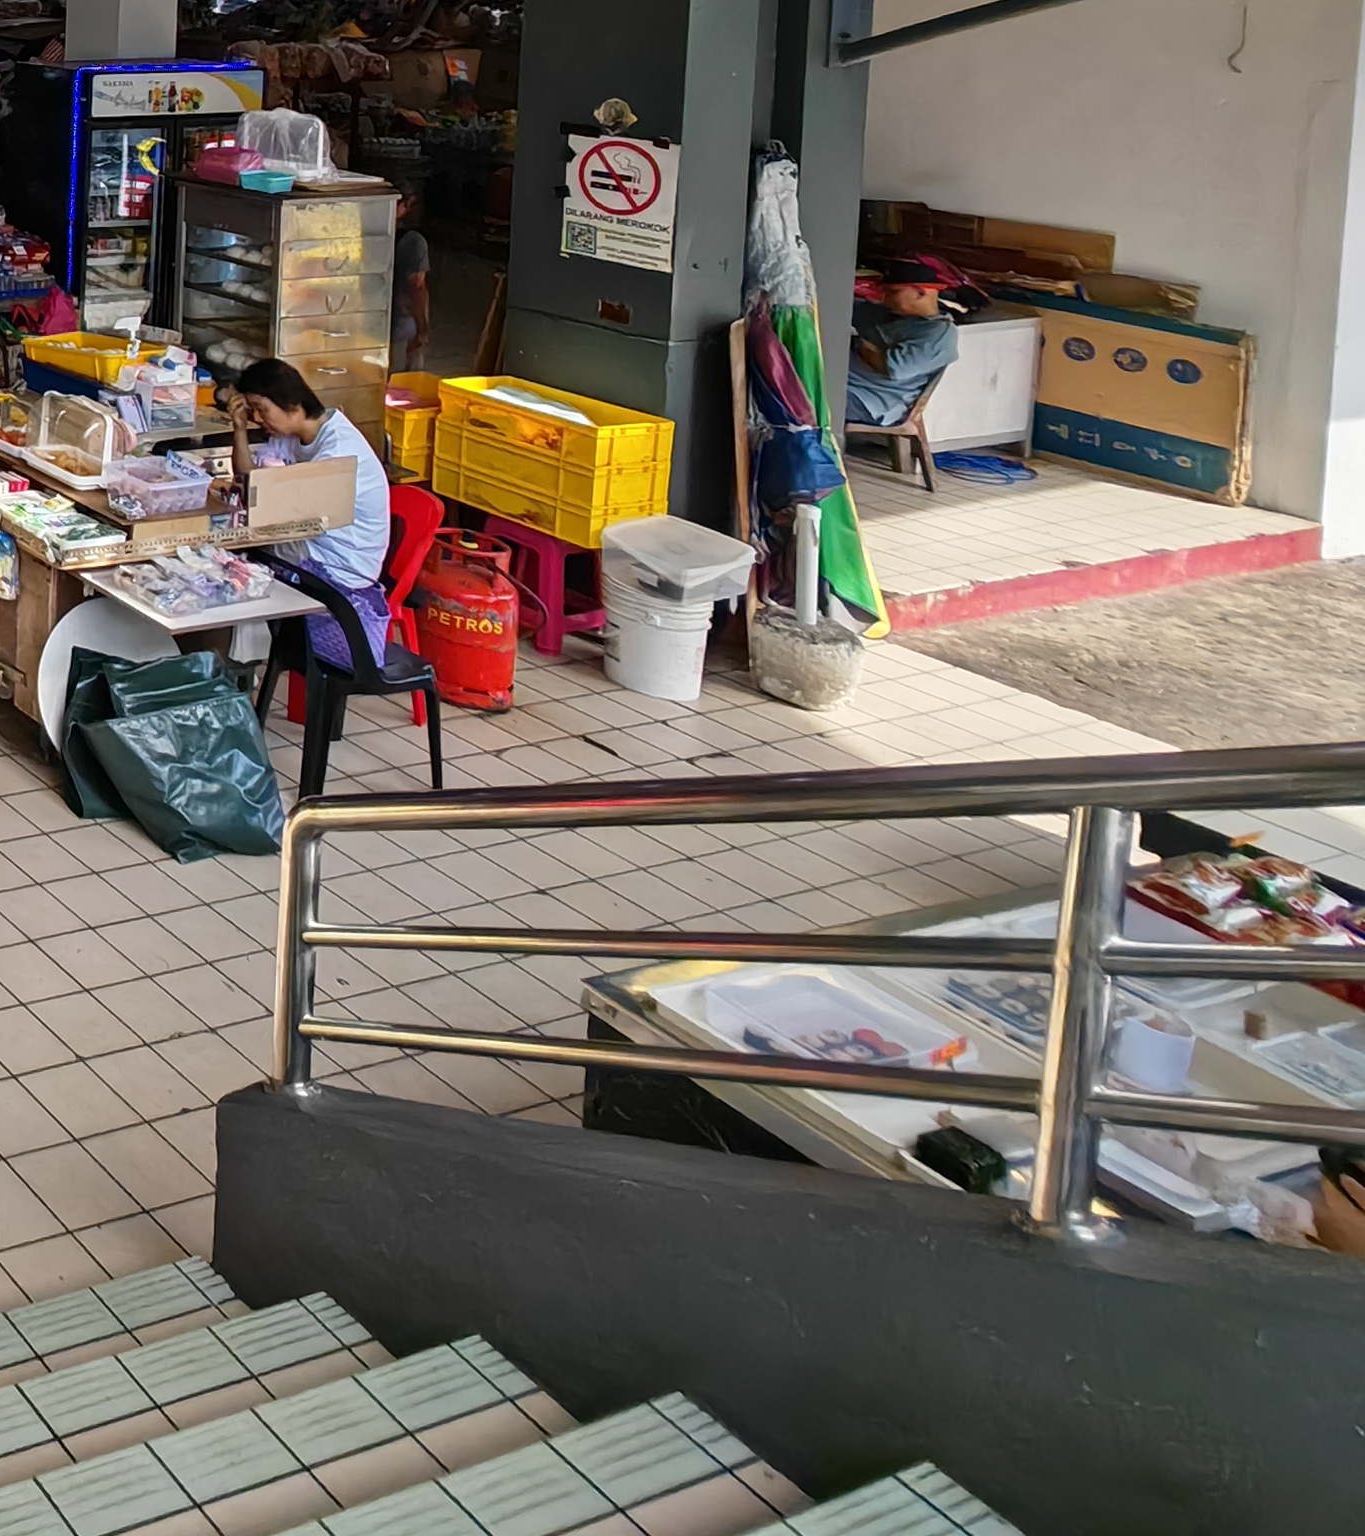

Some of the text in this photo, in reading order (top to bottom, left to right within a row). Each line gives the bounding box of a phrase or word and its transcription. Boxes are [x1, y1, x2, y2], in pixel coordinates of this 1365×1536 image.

[565, 207, 671, 234] DILARANG MEROKOK
[427, 607, 504, 636] PETROS
